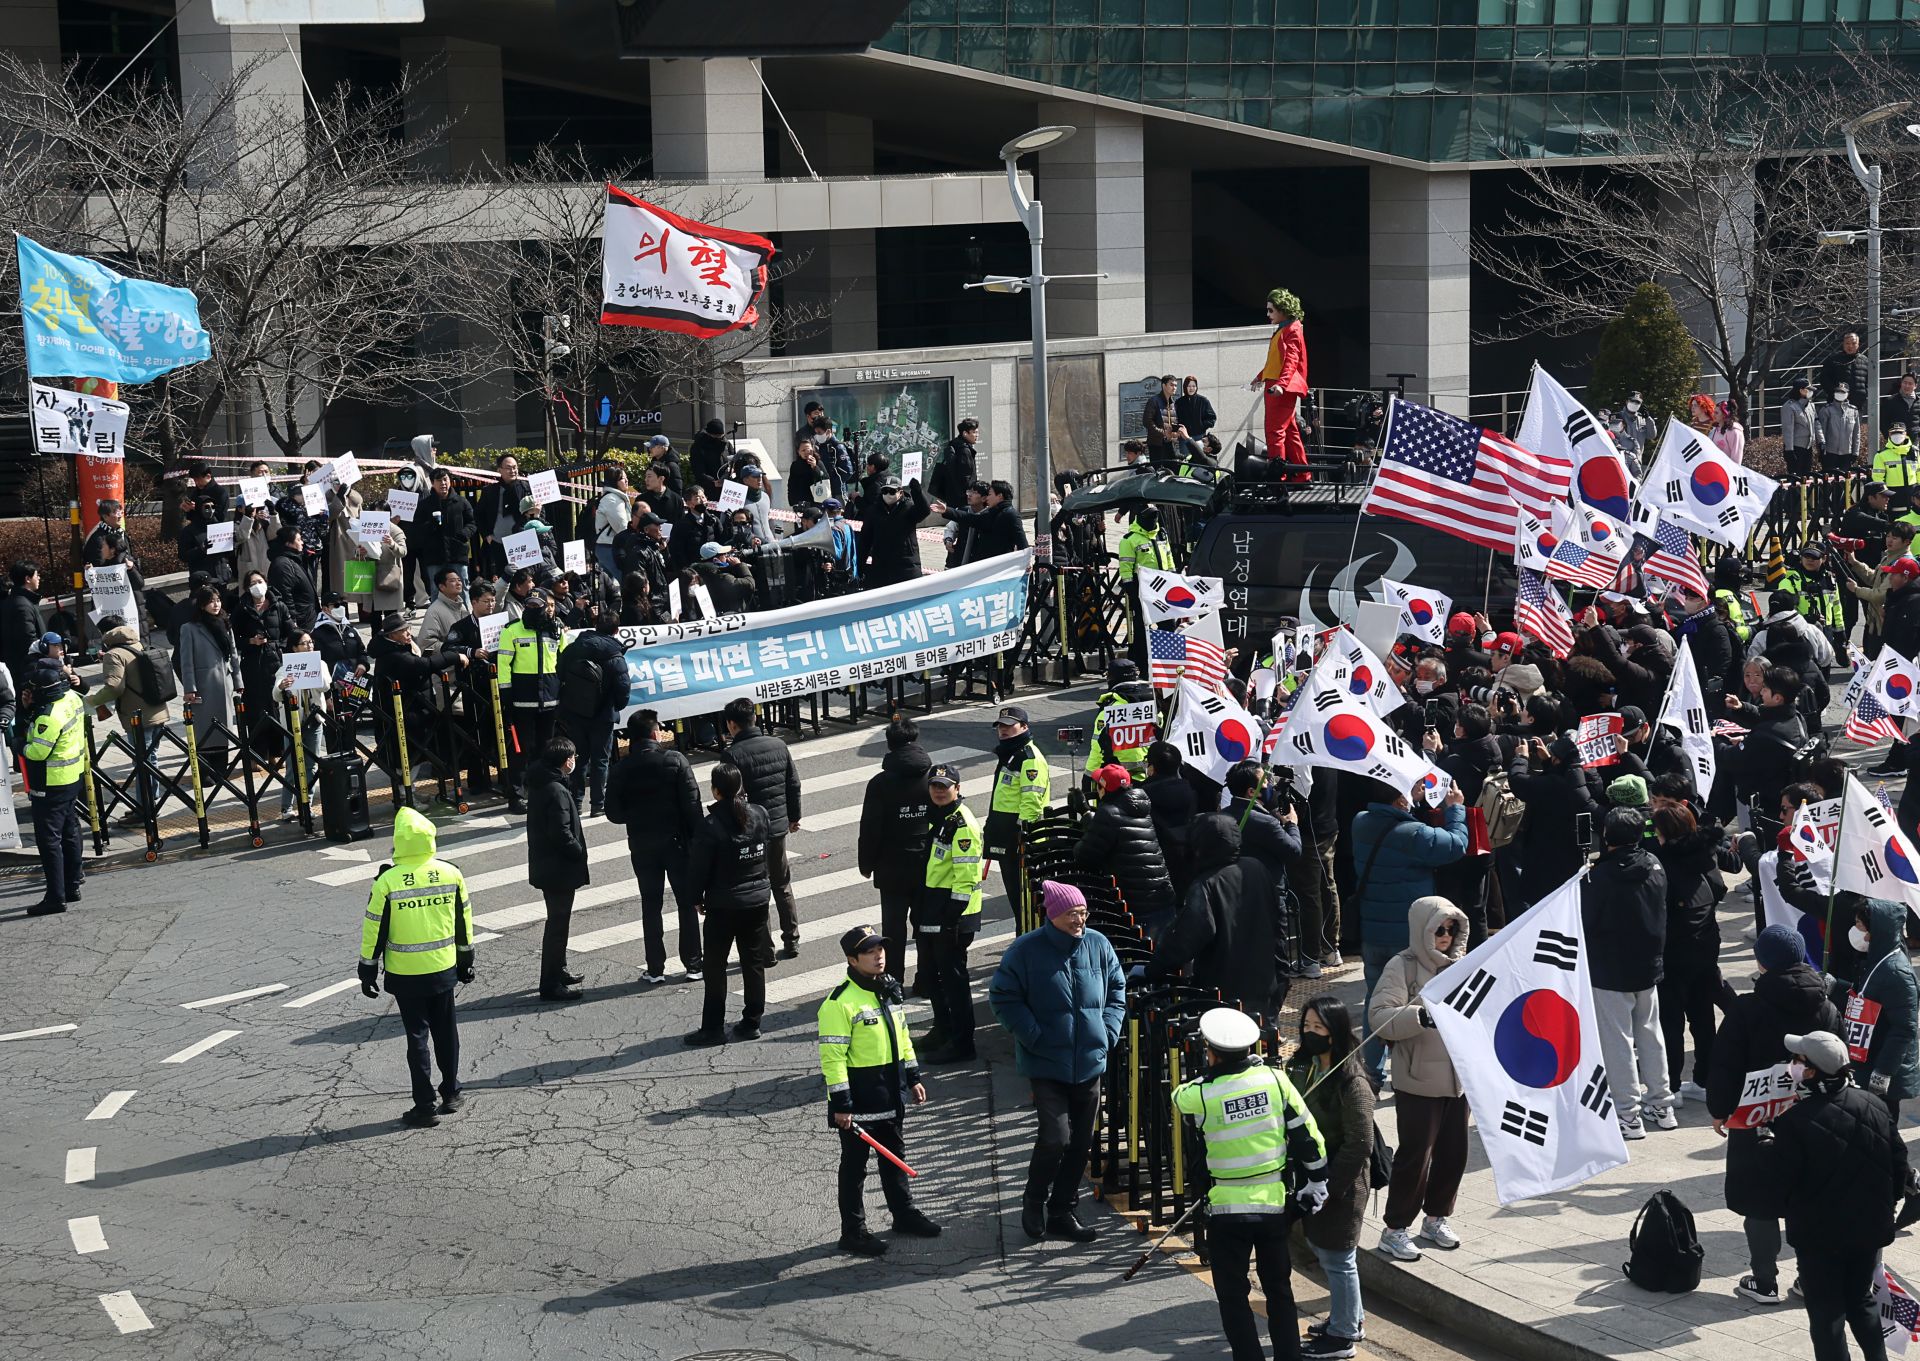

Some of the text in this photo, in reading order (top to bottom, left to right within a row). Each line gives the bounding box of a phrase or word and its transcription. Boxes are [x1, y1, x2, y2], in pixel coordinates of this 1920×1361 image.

[30, 278, 97, 332] 청년
[615, 282, 736, 316] 중앙대학교 민주동문회
[856, 368, 898, 380] 종합안내도
[36, 390, 60, 410] 자
[40, 427, 116, 454] 독 립
[508, 544, 526, 556] 윤석열
[1227, 530, 1254, 640] 남성연대
[618, 614, 747, 648] 앙인 시국선언!
[628, 590, 1015, 695] 석열 파면 촉구! 내란세력 척결!
[285, 663, 308, 672] 윤석열
[756, 670, 842, 699] 내란동조세력은
[849, 655, 907, 682] 의혈교정에
[914, 646, 949, 668] 들어올
[955, 638, 986, 658] 자리가
[1105, 704, 1154, 724] 거짓·속임
[1112, 725, 1147, 746] OUT
[188, 742, 197, 777] POLICE
[739, 851, 764, 860] POLICE
[397, 896, 451, 910] POLICE
[1744, 1071, 1794, 1098] 거짓·속
[1226, 1093, 1268, 1113] 교통경찰
[1230, 1107, 1268, 1121] POLICE
